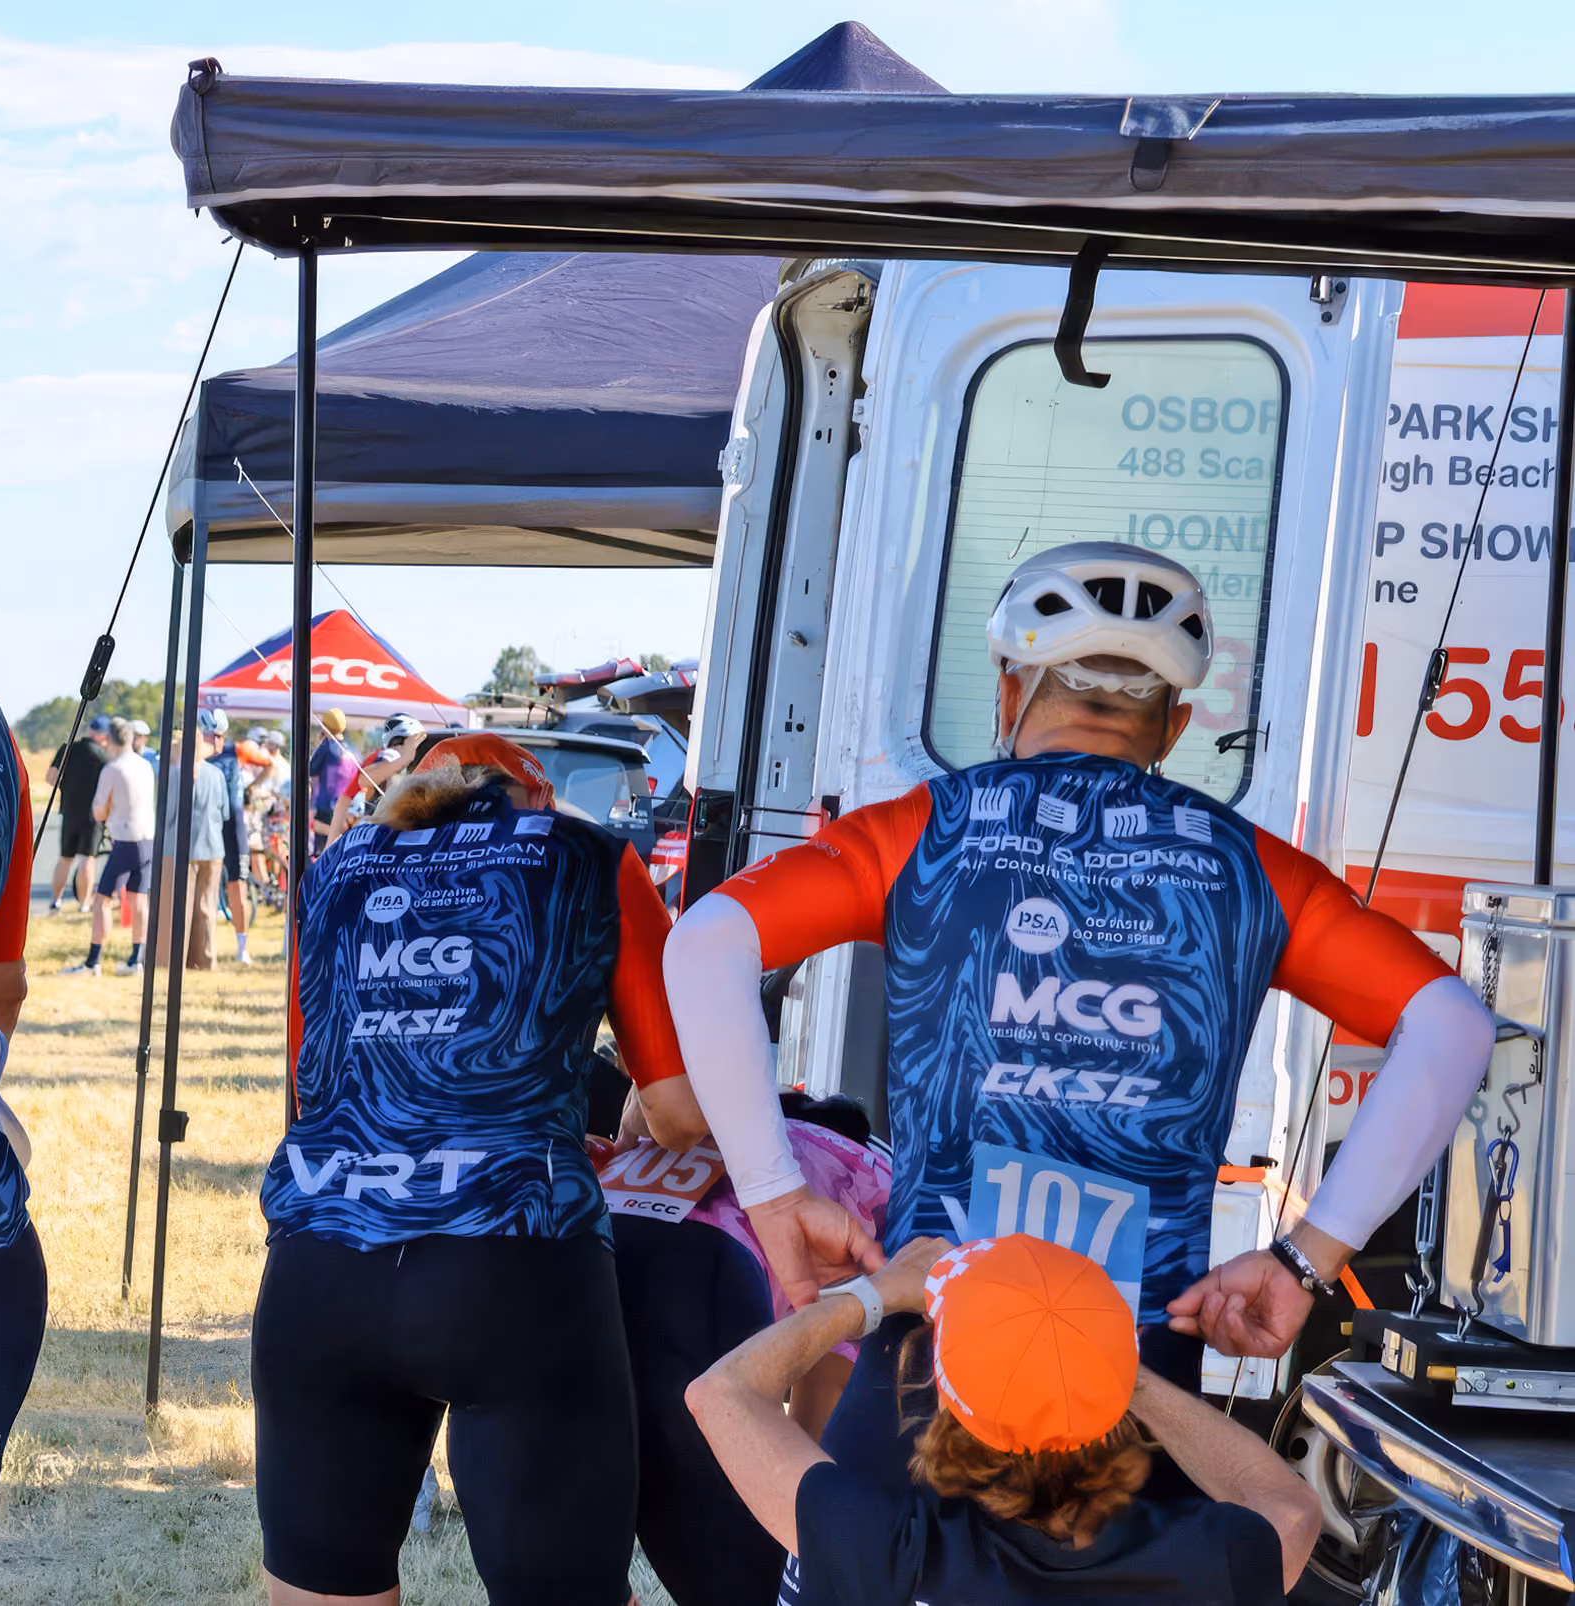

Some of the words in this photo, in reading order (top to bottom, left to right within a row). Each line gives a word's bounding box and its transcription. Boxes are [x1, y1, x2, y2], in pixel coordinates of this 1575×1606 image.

[1117, 446, 1185, 477] 488
[1199, 448, 1274, 480] Sca
[431, 843, 545, 863] DOONAN
[961, 836, 1043, 855] FORD
[1084, 849, 1220, 875] DOONAN
[1018, 911, 1059, 931] PSA
[358, 935, 473, 980] MCG
[350, 1008, 467, 1037] CKSC
[990, 973, 1161, 1037] MCG
[981, 1062, 1161, 1108] CKSC
[286, 1143, 488, 1200] VRT
[987, 1161, 1134, 1266] 107
